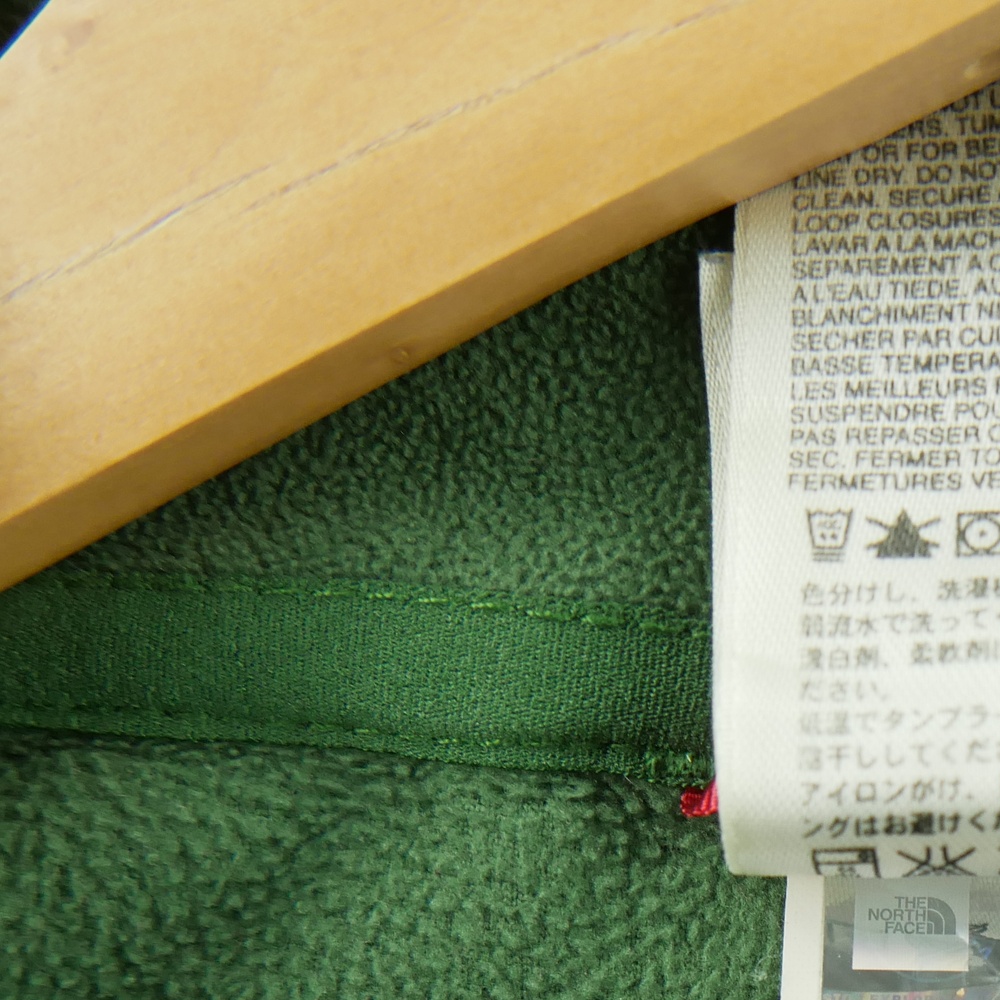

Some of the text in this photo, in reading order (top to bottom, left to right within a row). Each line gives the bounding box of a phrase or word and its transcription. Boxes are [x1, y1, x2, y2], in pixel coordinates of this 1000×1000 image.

[941, 90, 984, 113] OT
[863, 143, 899, 163] OR
[907, 140, 958, 161] FOR
[916, 165, 952, 185] DO
[889, 185, 991, 208] SECURE
[792, 213, 860, 234] LOOP
[875, 234, 890, 252] A
[897, 233, 927, 252] LA
[792, 255, 961, 280] SEPAREMENT
[968, 254, 982, 270] A
[793, 284, 808, 303] A
[791, 302, 971, 328] BLANCHIMENT
[978, 301, 1000, 320] NI
[791, 328, 894, 351] SECHER
[904, 328, 951, 348] PAR
[791, 354, 873, 376] BASSE
[791, 379, 837, 400] LES
[844, 376, 987, 399] MEILLEURS
[790, 402, 947, 424] SUSPENDRE
[790, 427, 837, 446] PAS
[846, 424, 980, 446] REPASSER
[855, 449, 961, 468] FERMER
[788, 472, 962, 491] FERMETURES
[895, 896, 927, 909] THE
[868, 908, 927, 922] NORTH
[884, 922, 927, 935] FACE
